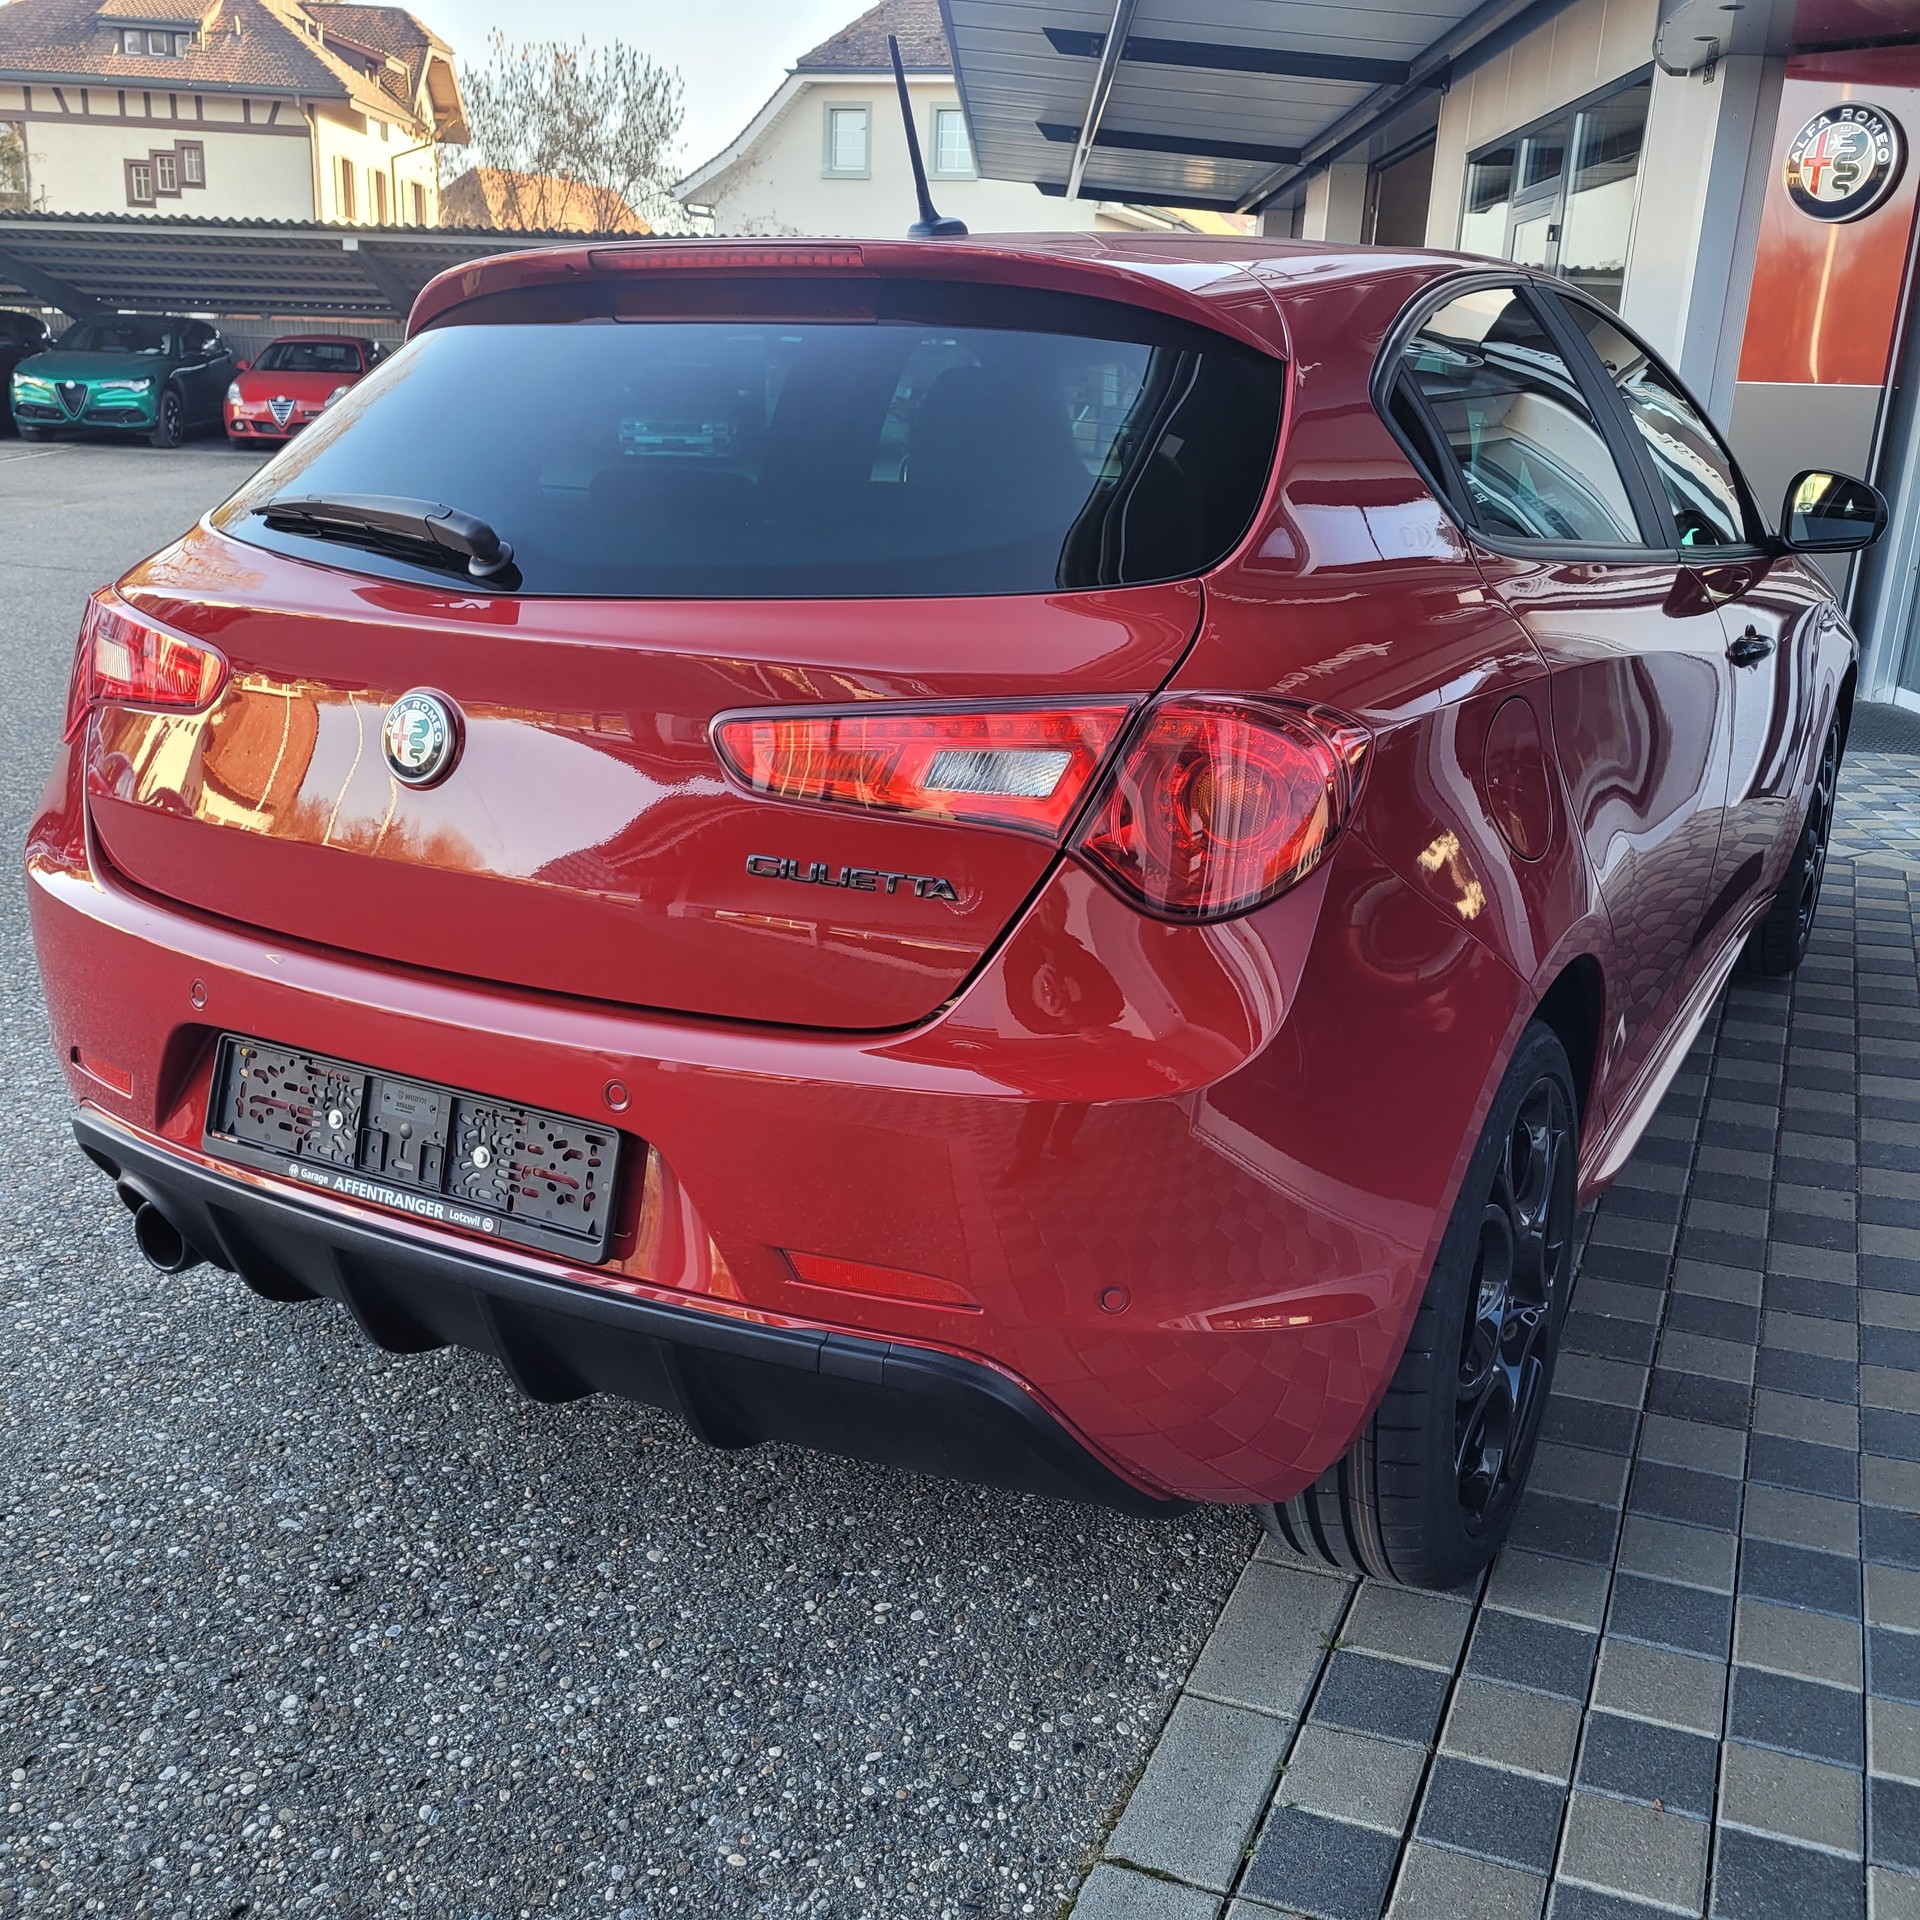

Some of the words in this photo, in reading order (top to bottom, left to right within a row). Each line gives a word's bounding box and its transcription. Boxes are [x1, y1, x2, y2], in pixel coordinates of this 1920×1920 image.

[1791, 115, 1831, 164] ALFA
[1840, 108, 1889, 163] ROMEO
[385, 705, 408, 737] ALFA
[412, 700, 442, 743] ROMEO
[746, 854, 959, 901] GIULIETTA
[301, 1168, 329, 1185] Garage
[333, 1176, 443, 1219] AFFENTRANGER
[449, 1209, 481, 1227] Lotzwil
